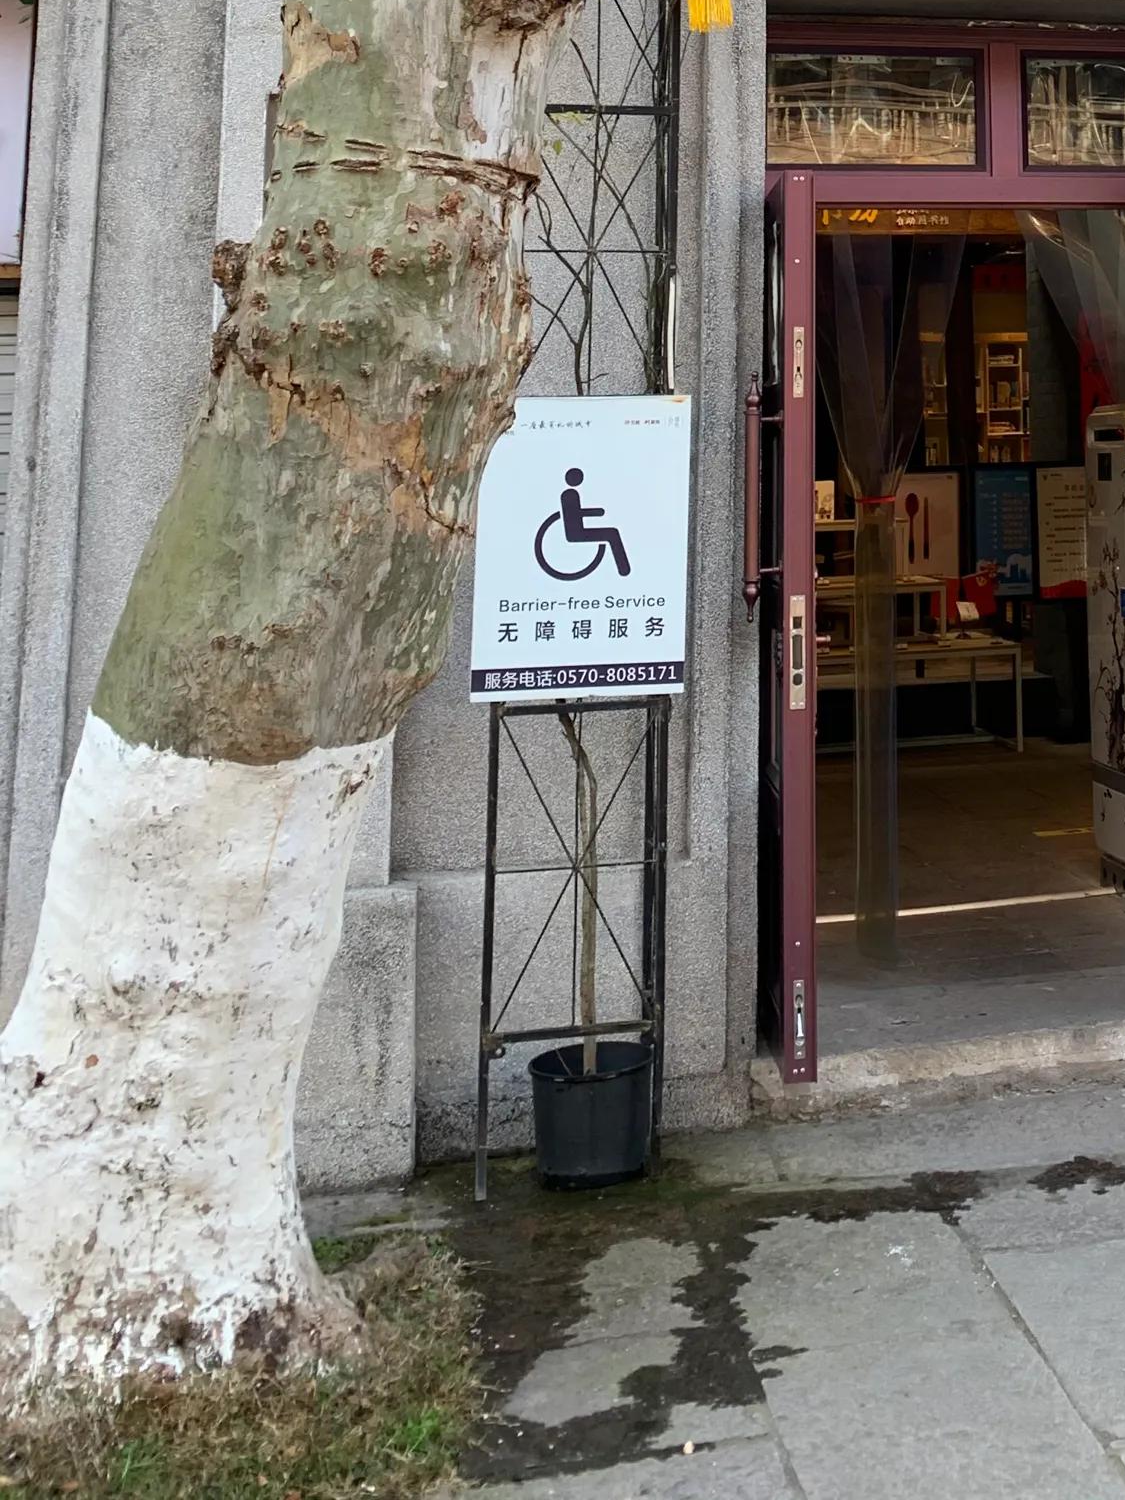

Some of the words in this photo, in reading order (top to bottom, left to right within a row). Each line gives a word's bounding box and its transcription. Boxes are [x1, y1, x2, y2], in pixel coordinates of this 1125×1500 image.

[499, 597, 601, 613] Barrier-free
[604, 594, 666, 609] Service
[497, 616, 665, 643] 无障碍服务
[484, 664, 678, 690] 服务电话:0570-8085171
